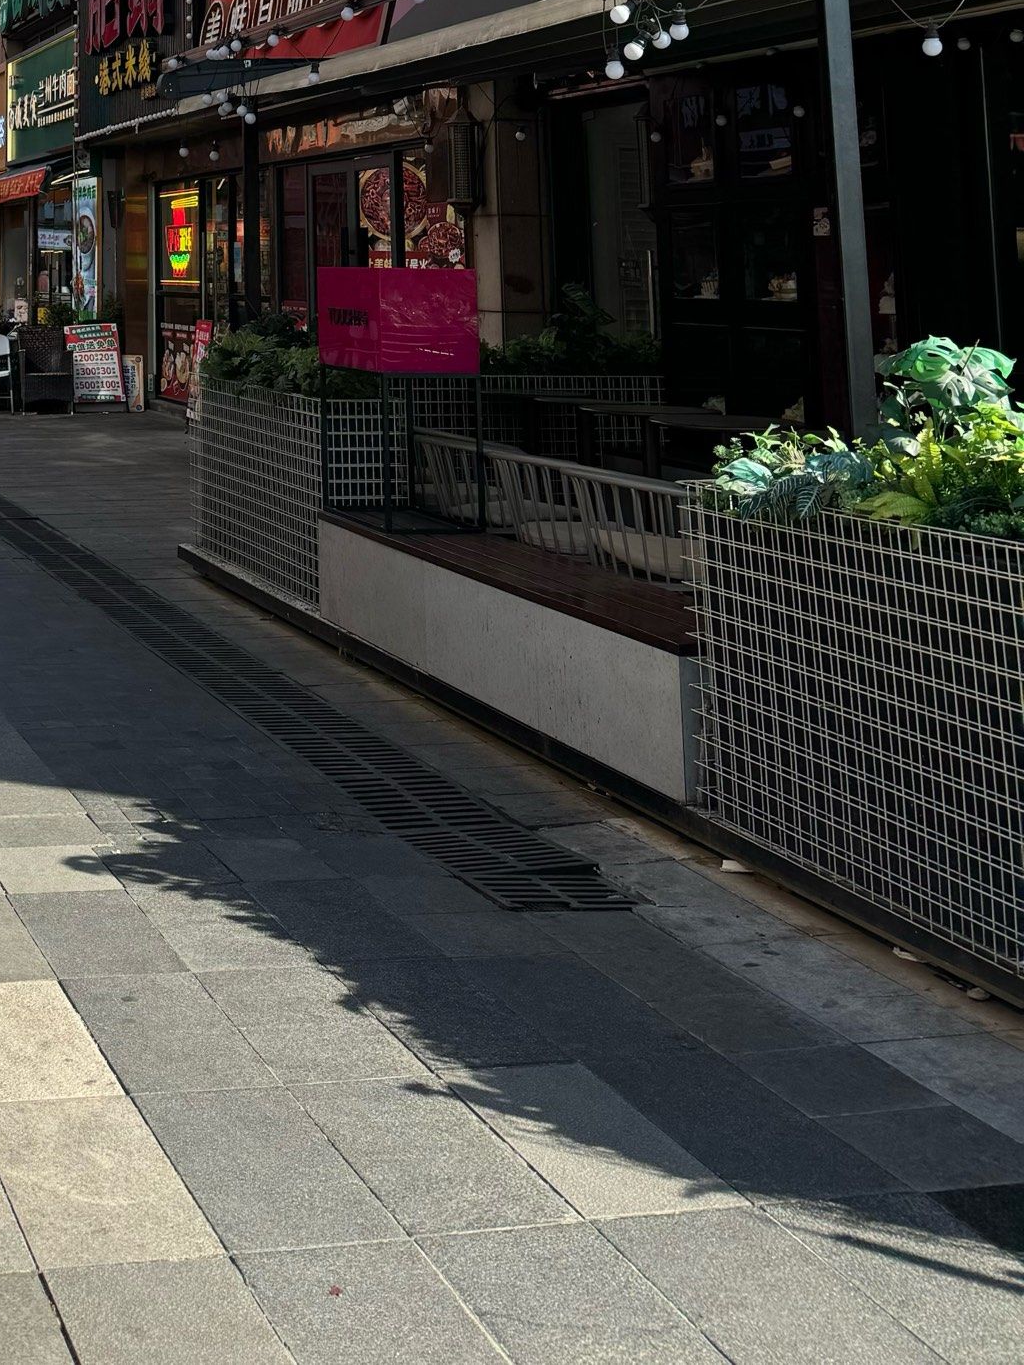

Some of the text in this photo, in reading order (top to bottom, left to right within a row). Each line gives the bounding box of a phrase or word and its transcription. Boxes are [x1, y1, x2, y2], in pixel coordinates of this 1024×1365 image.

[78, 353, 110, 362] 200 20
[80, 367, 111, 376] 300 30
[100, 381, 116, 389] 100
